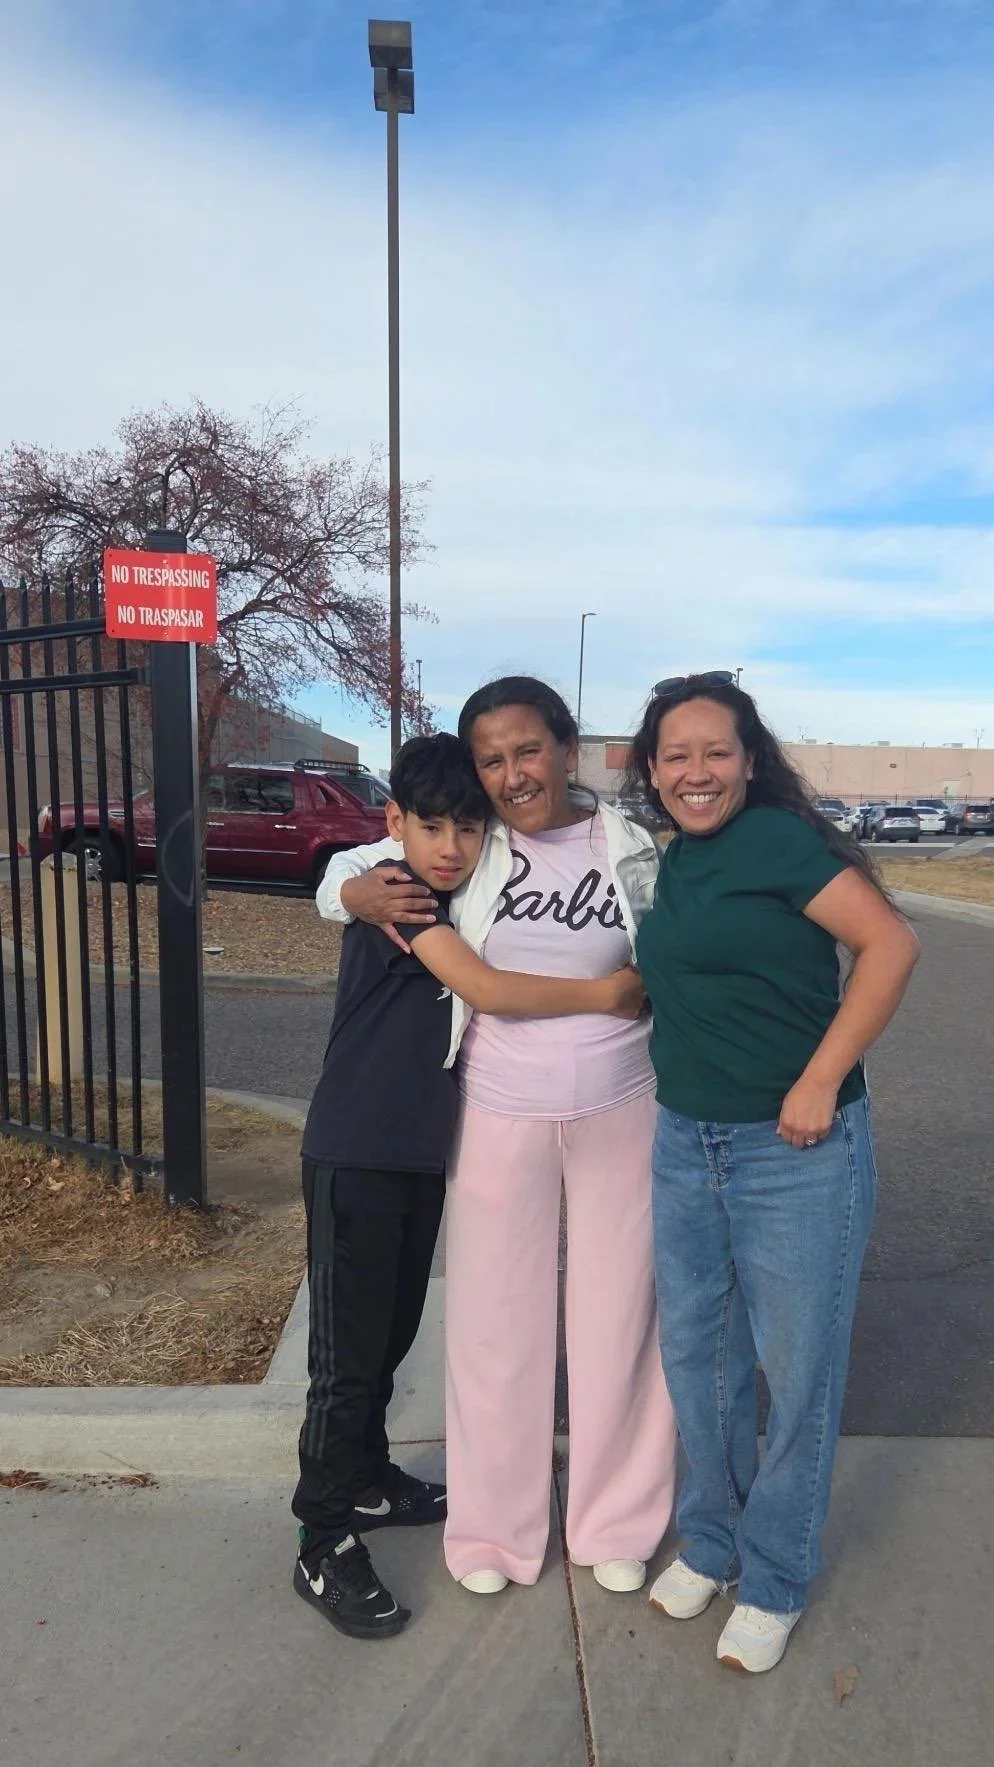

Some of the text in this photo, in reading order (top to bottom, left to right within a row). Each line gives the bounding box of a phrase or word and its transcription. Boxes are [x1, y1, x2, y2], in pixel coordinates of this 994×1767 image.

[111, 565, 210, 589] NO TRESPASSING
[117, 605, 204, 628] NO TRASPASAR
